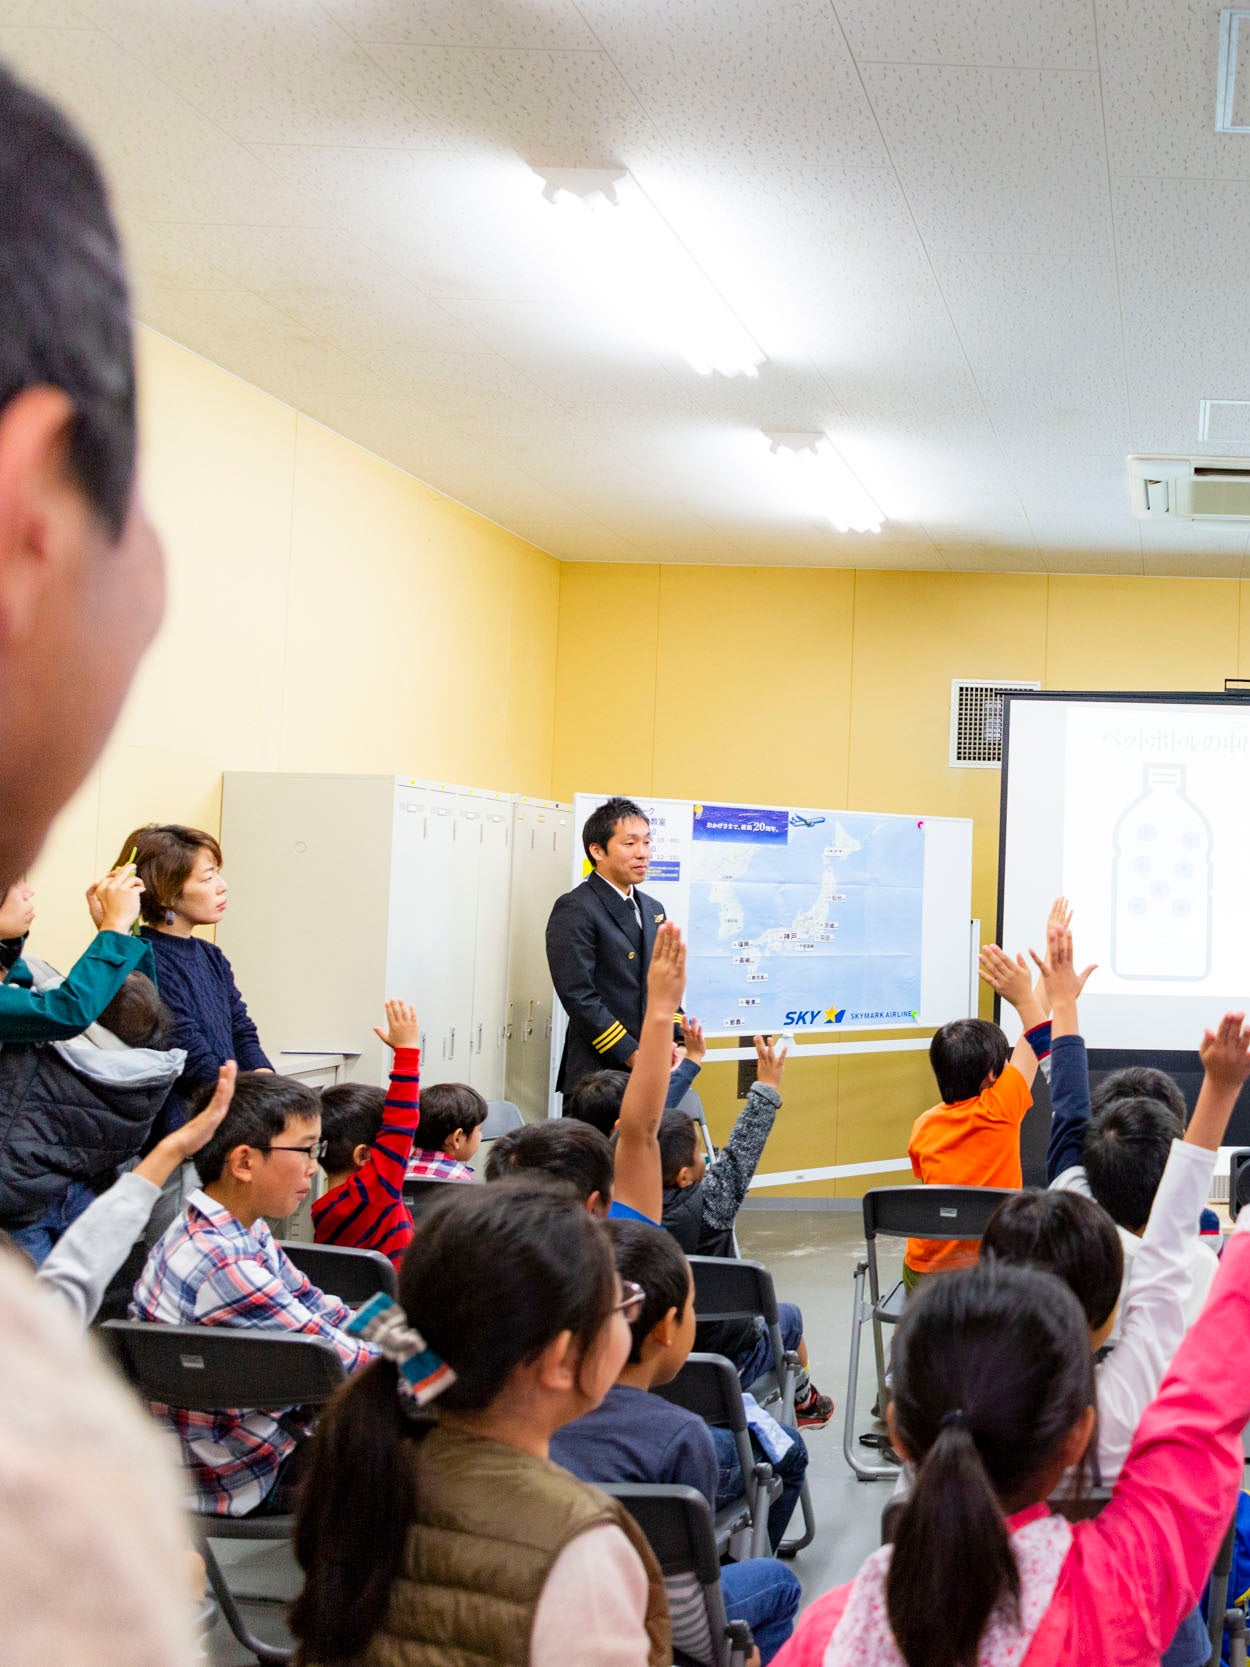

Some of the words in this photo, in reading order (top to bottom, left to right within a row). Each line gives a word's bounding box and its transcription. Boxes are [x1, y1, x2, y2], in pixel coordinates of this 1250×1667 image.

[783, 1010, 822, 1026] SKY
[851, 1012, 884, 1020] SKYMARK
[885, 1010, 912, 1018] AIRLINE
